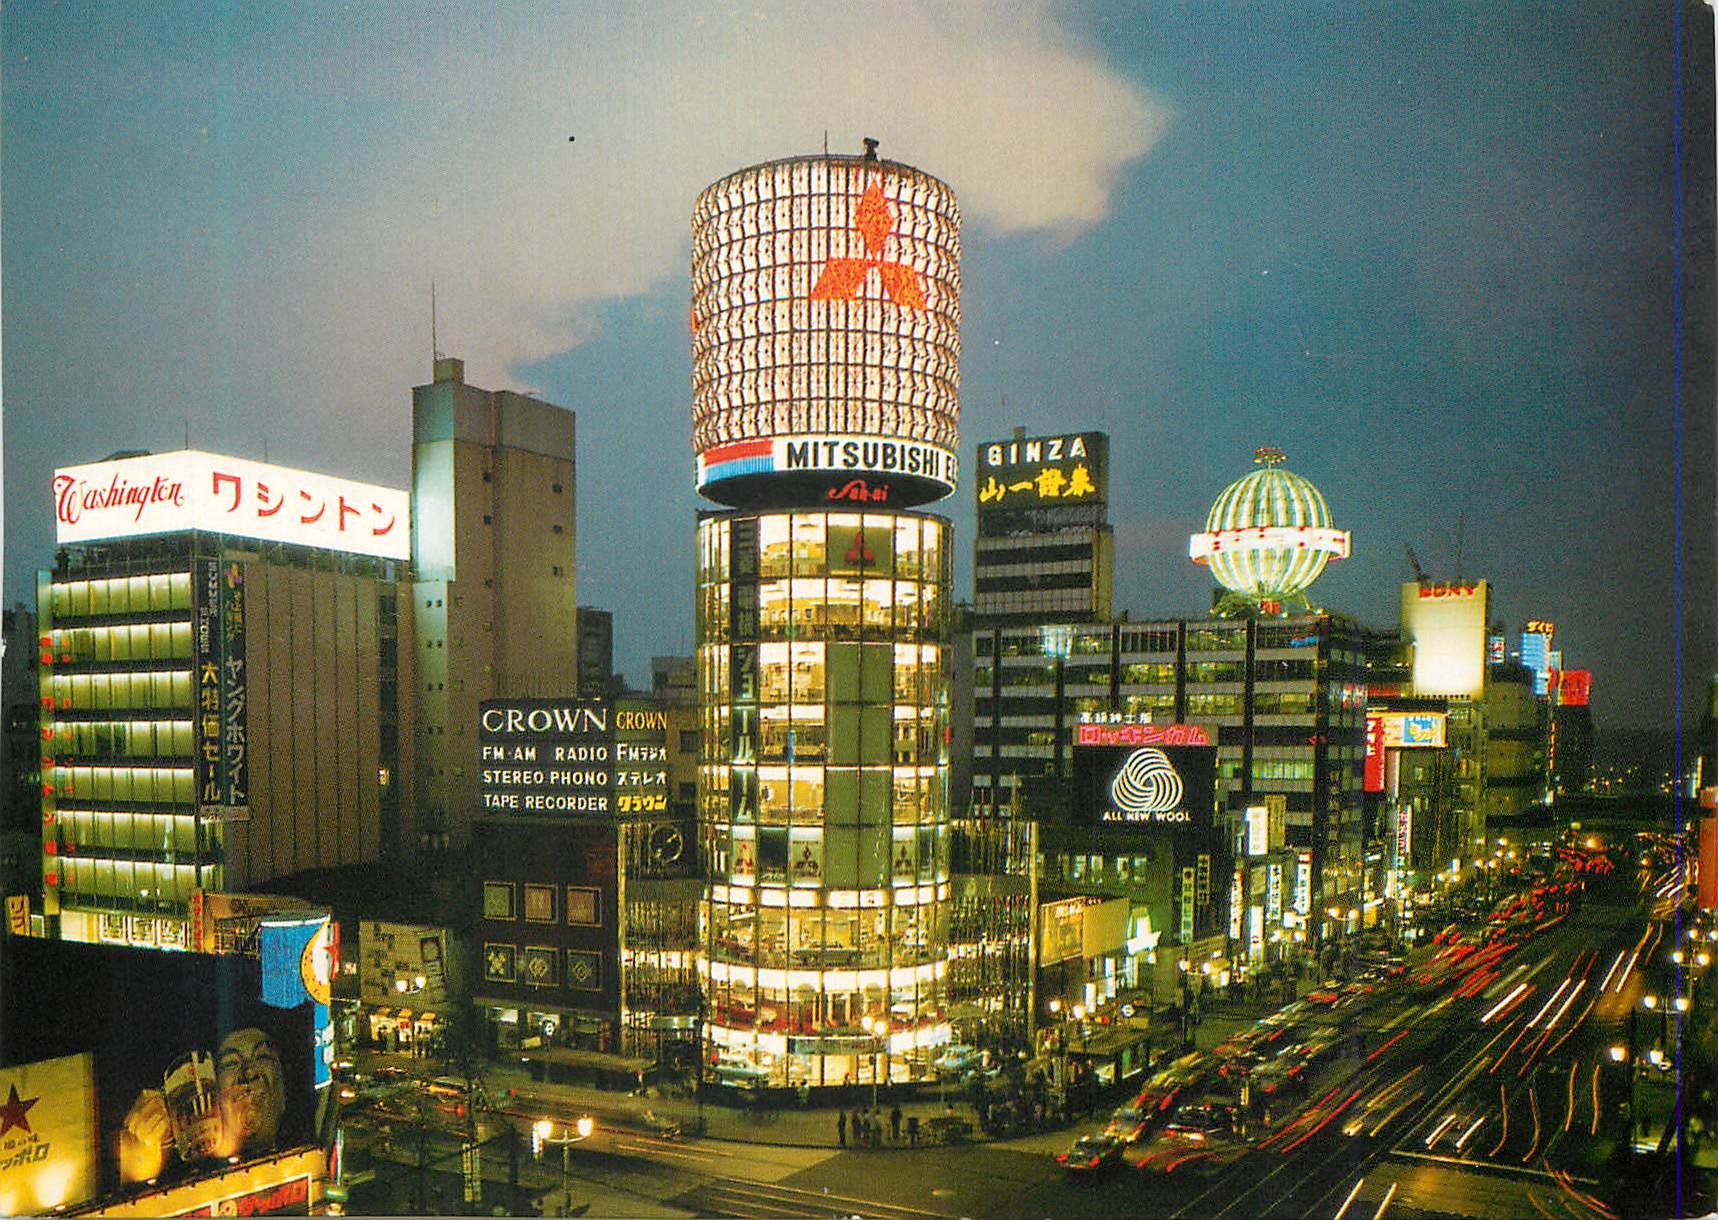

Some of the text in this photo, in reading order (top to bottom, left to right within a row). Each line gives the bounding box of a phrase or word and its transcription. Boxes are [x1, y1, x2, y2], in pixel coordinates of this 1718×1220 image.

[787, 441, 939, 477] MITSUBISHI
[988, 436, 1087, 466] GINZA
[53, 471, 185, 526] Washington
[213, 471, 397, 537] ワシントン
[1419, 585, 1477, 600] SONY
[226, 655, 246, 805] ヤングホワイト
[482, 707, 608, 733] CROWN
[616, 710, 668, 731] CROWN
[201, 660, 221, 802] 大特価セール
[555, 746, 608, 762] RADIO
[483, 770, 608, 786] STEREO PHONO
[617, 771, 668, 786] ステレオ
[483, 794, 608, 812] TAPE RECORDER
[617, 794, 668, 812] クラウン
[1103, 811, 1123, 822] ALL
[1155, 811, 1191, 822] WOOL
